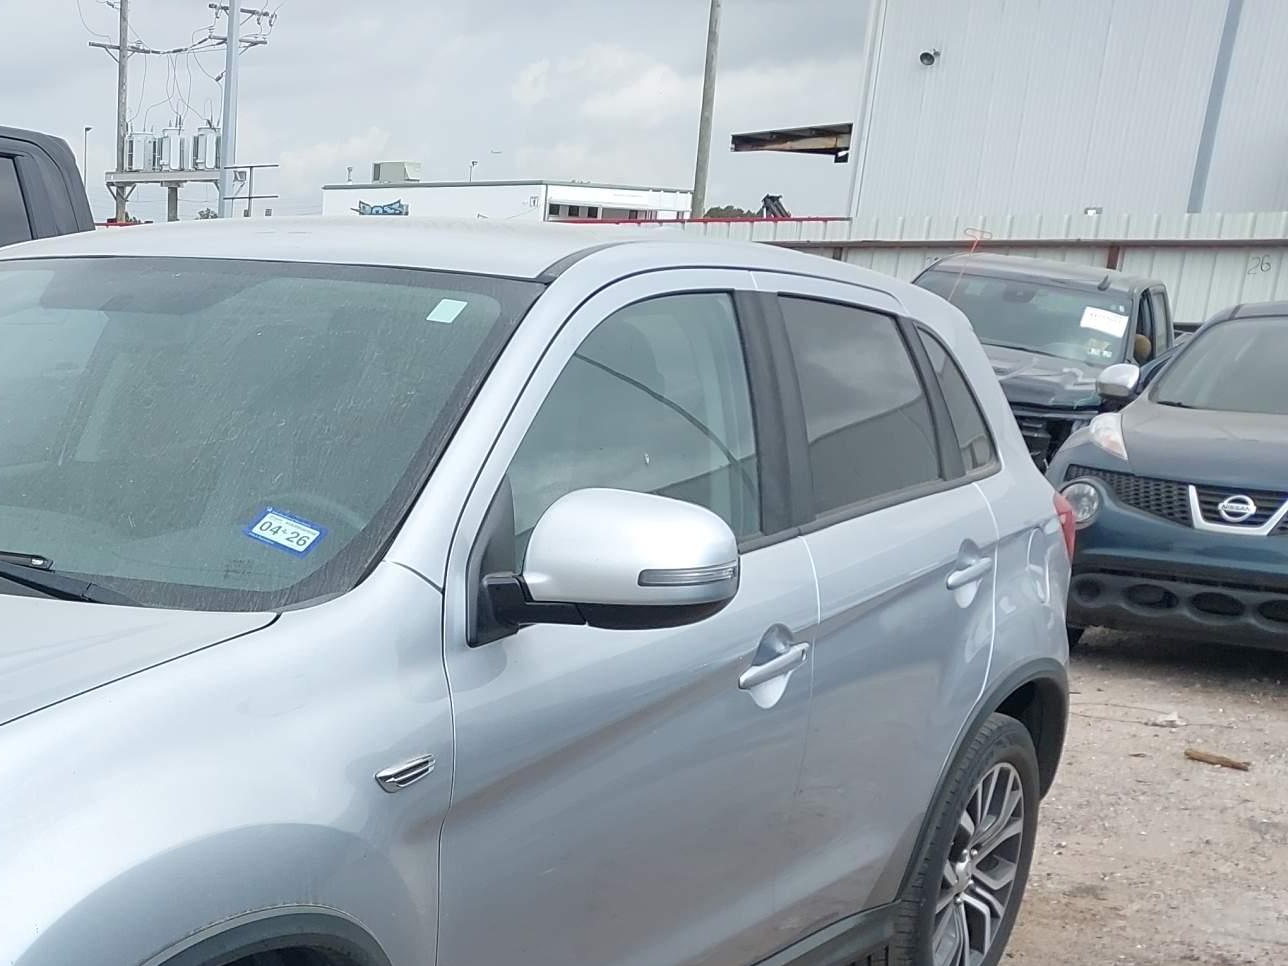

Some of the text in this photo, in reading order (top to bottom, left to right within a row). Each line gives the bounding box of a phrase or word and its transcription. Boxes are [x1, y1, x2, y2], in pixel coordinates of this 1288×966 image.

[1247, 254, 1272, 275] 26
[259, 520, 283, 536] 04
[285, 531, 311, 547] 26
